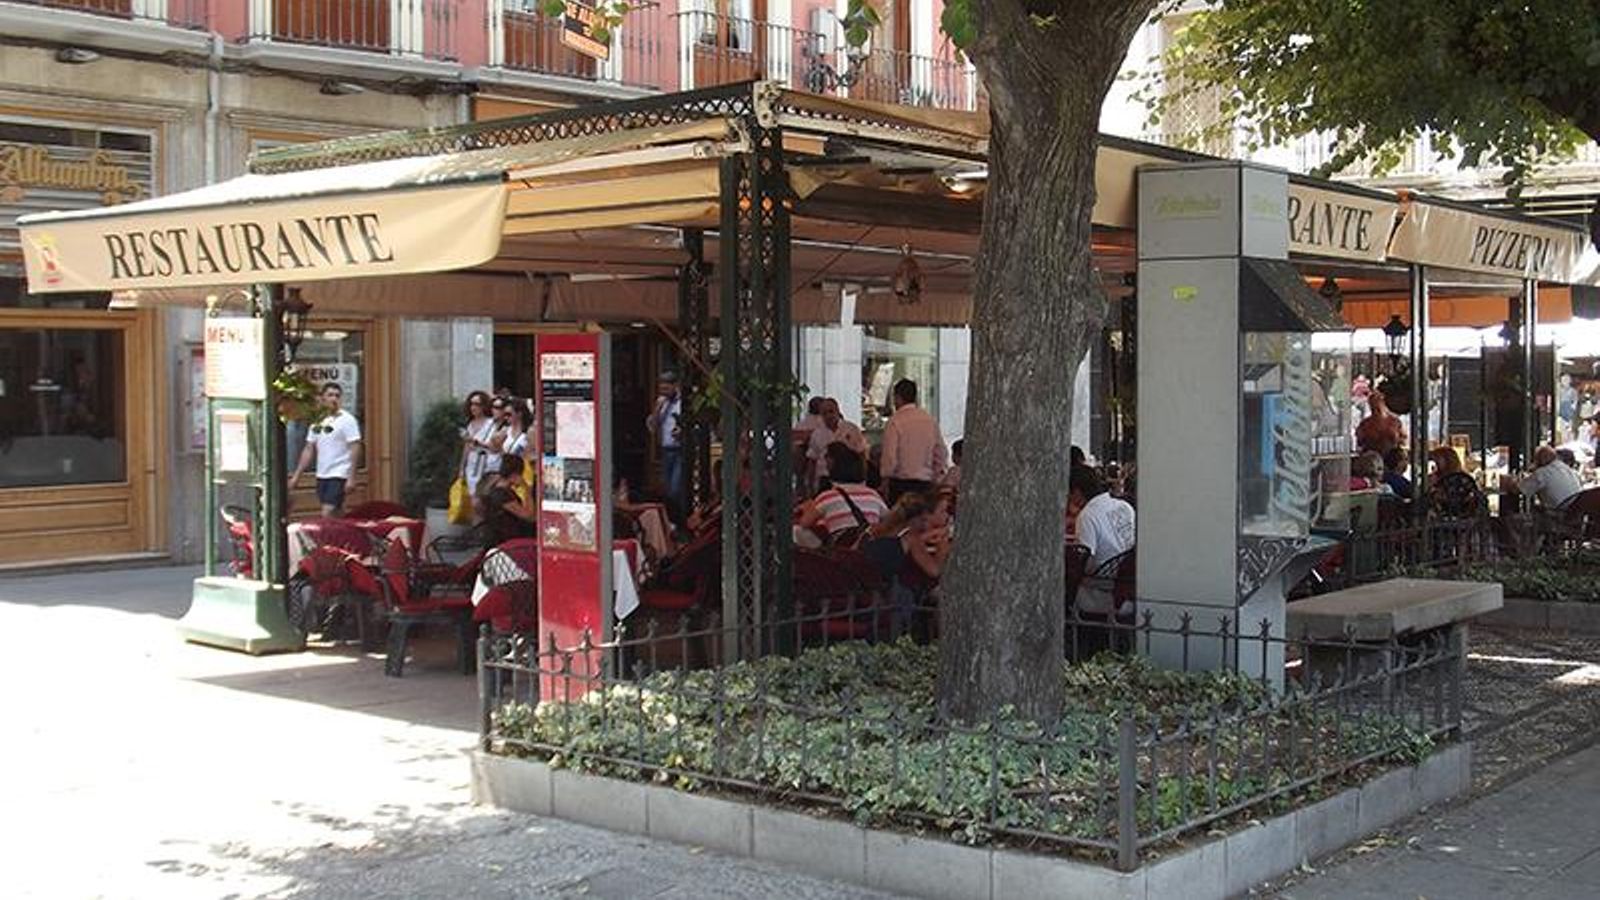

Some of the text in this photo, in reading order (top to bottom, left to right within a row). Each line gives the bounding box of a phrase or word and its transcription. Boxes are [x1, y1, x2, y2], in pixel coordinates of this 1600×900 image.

[0, 144, 132, 192] Alhambra
[104, 212, 395, 280] RESTAURANTE
[1287, 196, 1374, 252] RANTE
